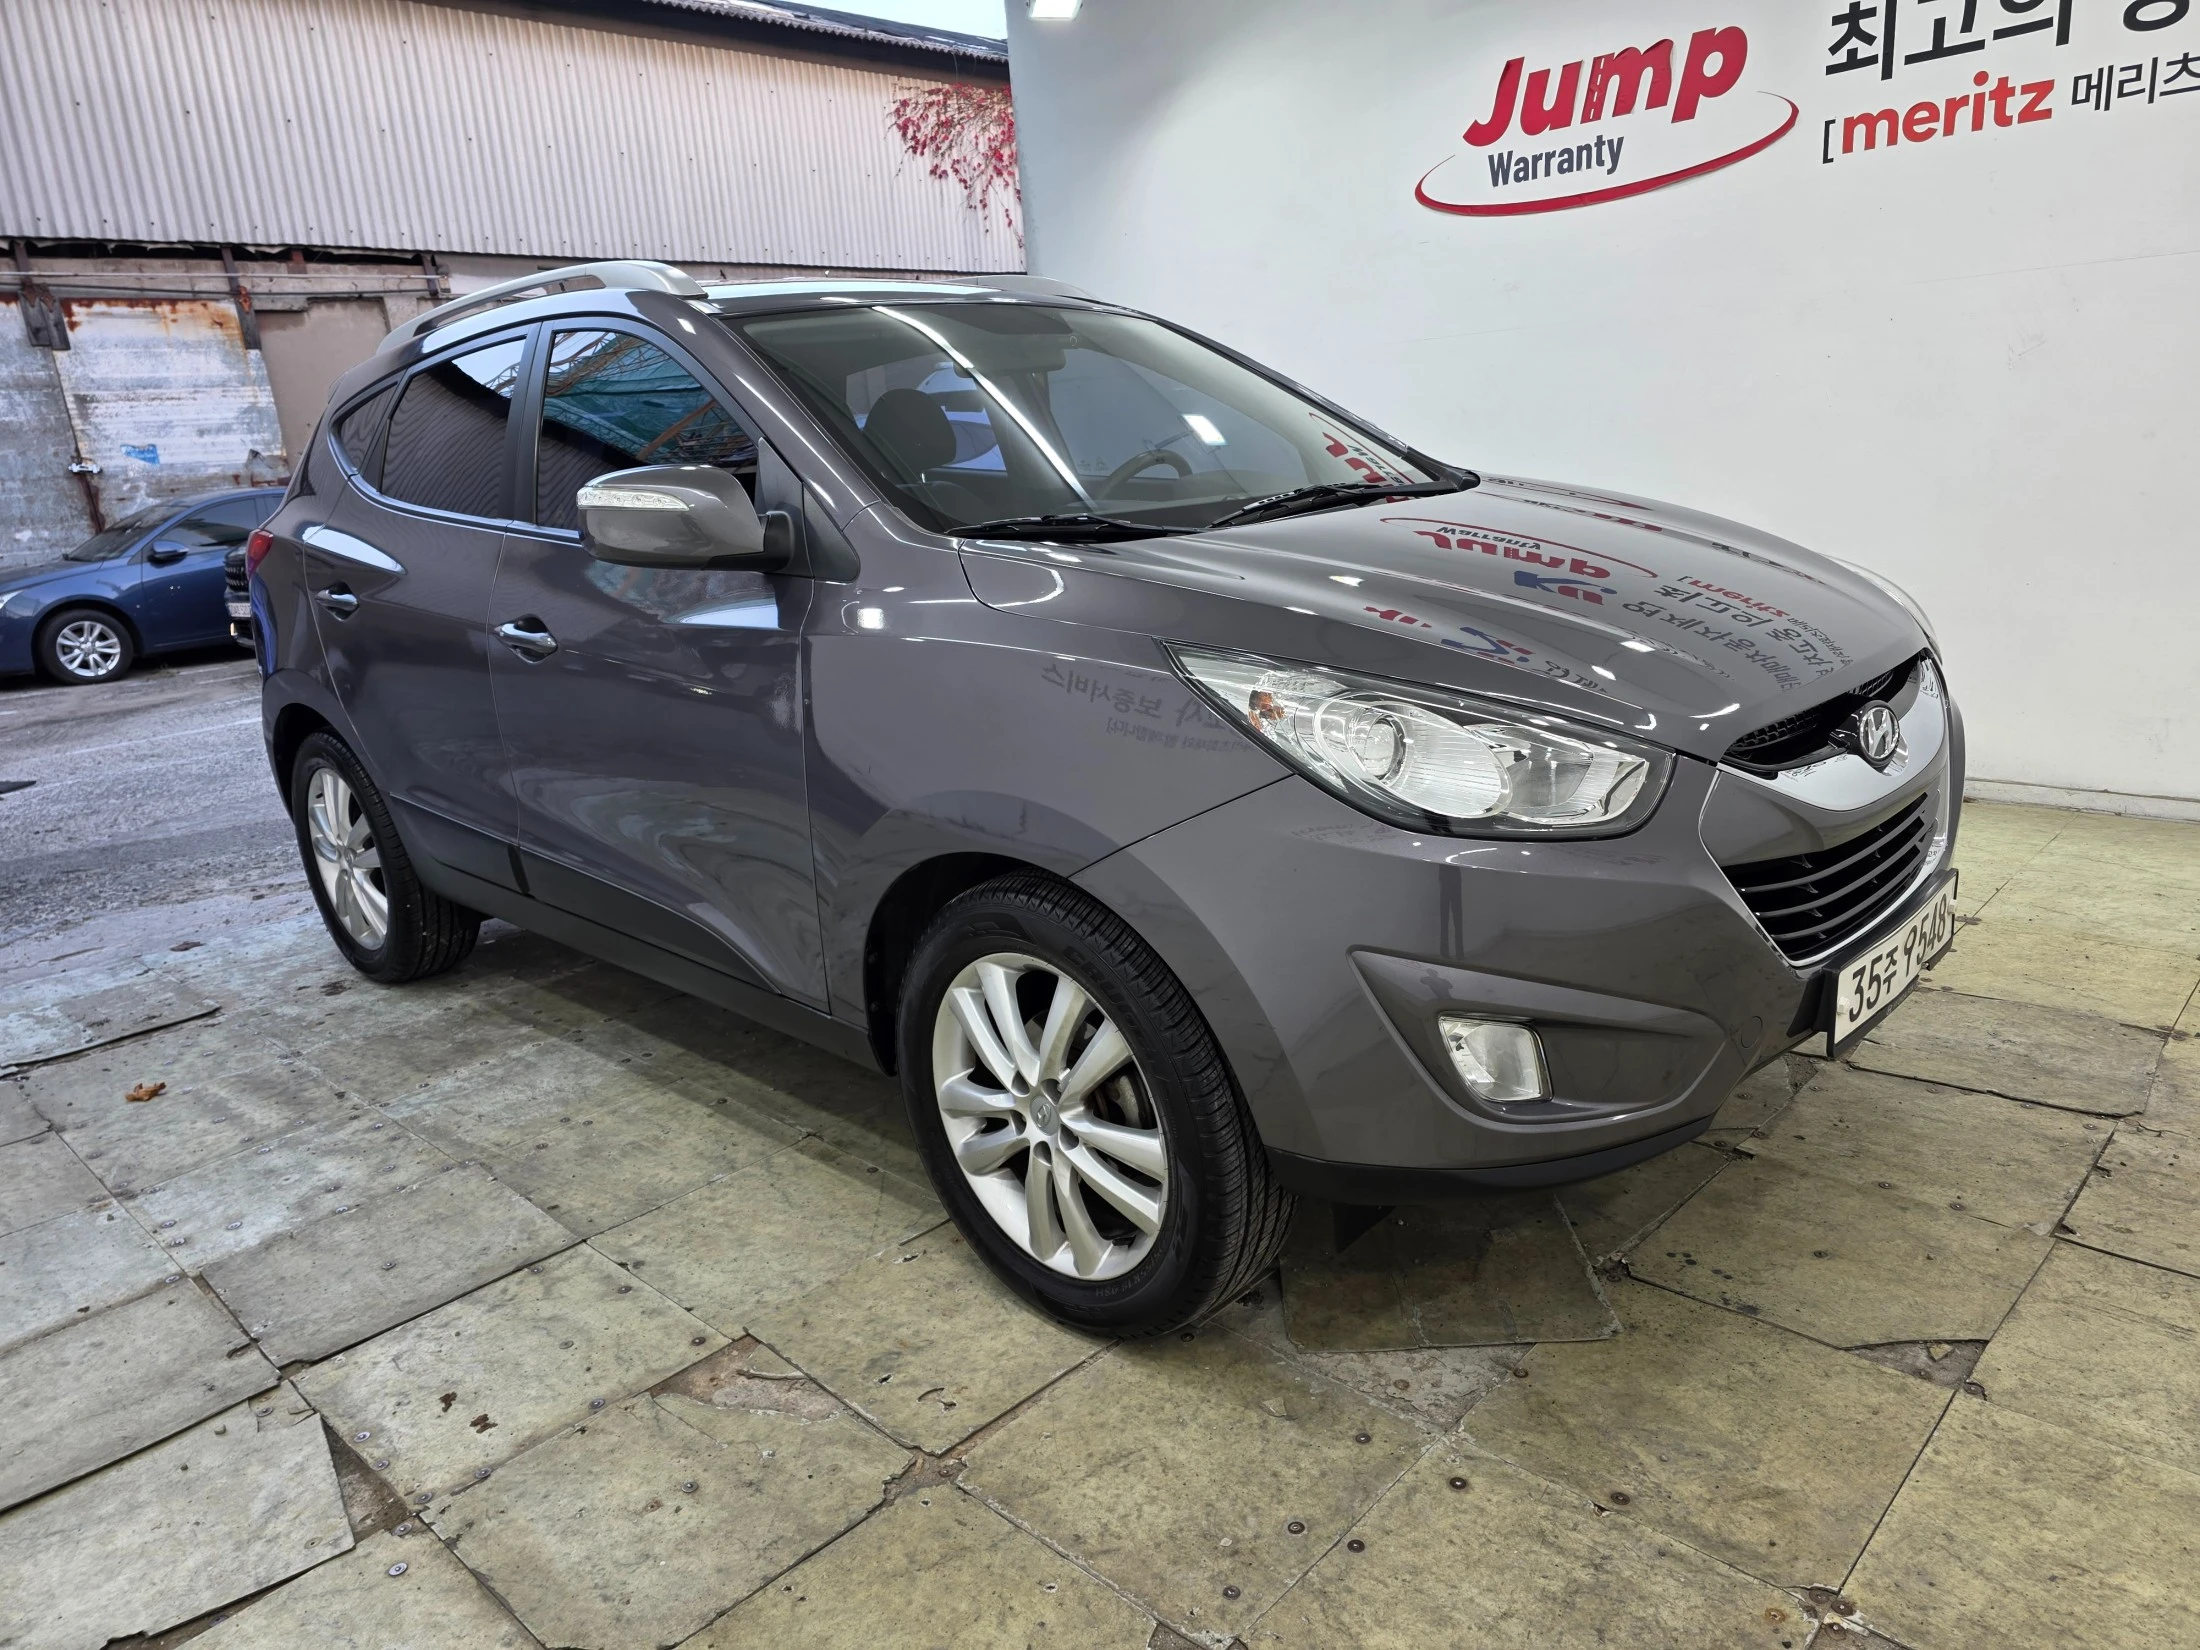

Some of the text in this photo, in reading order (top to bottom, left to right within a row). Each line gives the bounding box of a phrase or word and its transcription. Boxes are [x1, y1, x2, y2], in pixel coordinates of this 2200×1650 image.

[1463, 26, 1748, 147] Jump
[1488, 135, 1625, 187] Warranty
[1848, 893, 1947, 1023] 35주 9548
